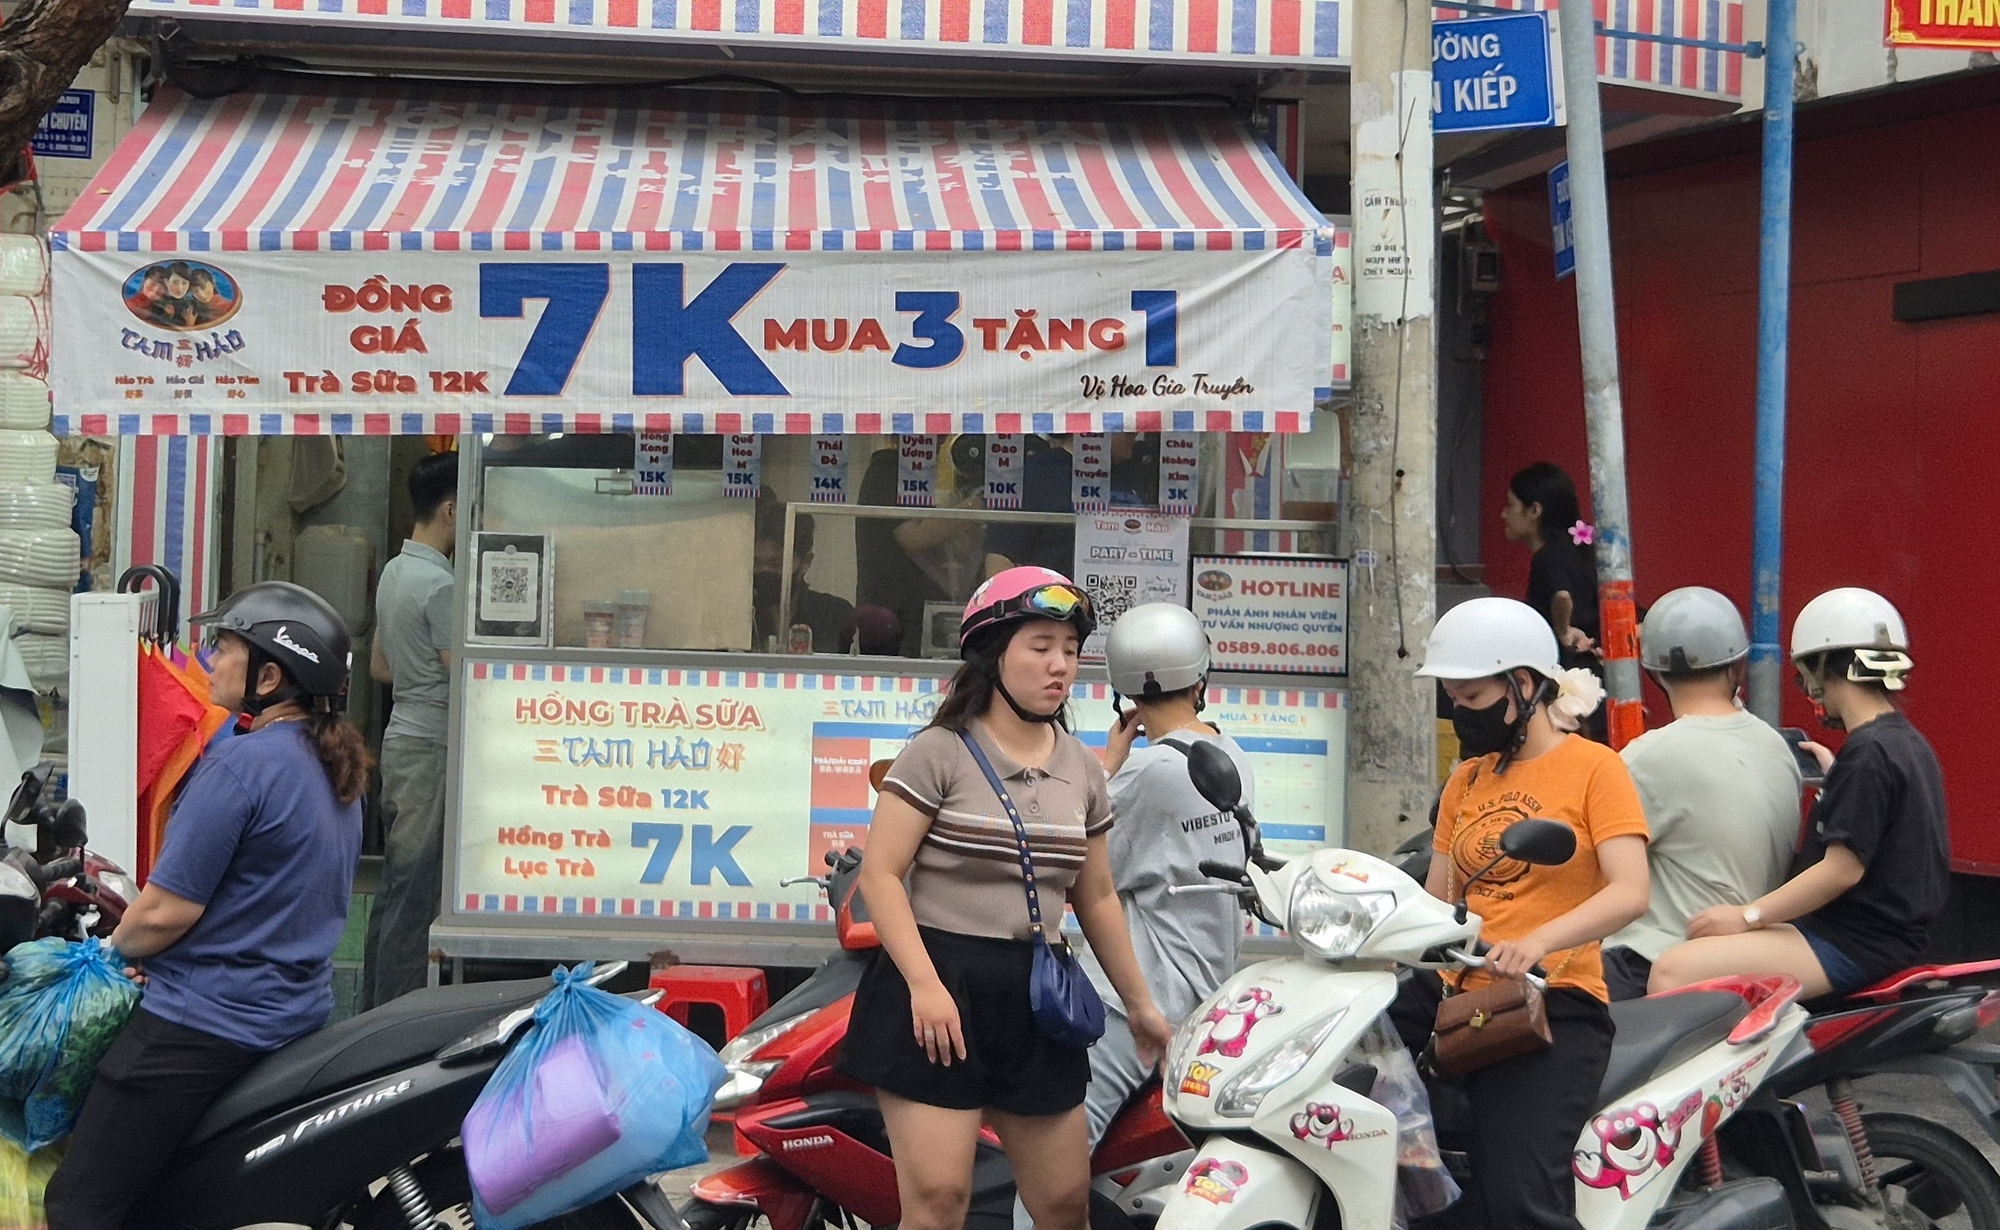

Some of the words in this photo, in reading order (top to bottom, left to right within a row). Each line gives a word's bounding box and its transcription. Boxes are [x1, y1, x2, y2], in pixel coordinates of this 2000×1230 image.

[1453, 63, 1518, 112] KIẾP
[321, 274, 453, 314] ĐỒNG
[350, 318, 430, 355] GIÁ
[480, 263, 793, 397] 7K
[763, 318, 894, 354] MUA
[891, 291, 968, 372] 3
[972, 308, 1127, 362] TẶNG
[1131, 290, 1180, 369] 1
[121, 327, 174, 362] TAM
[194, 329, 246, 362] HẢO
[283, 369, 342, 395] Trà
[351, 369, 418, 395] Sữa
[428, 370, 492, 395] 12K
[1080, 375, 1106, 400] Vị
[1110, 374, 1148, 397] Hoa
[1152, 374, 1187, 396] Gia
[998, 457, 1010, 467] M
[639, 471, 666, 483] 15K
[726, 473, 754, 485] 15K
[814, 477, 842, 489] 14K
[902, 480, 929, 492] 15K
[989, 482, 1017, 494] 10K
[1081, 486, 1101, 498] 5K
[1168, 489, 1188, 500] 3K
[1090, 546, 1127, 559] PART
[1139, 548, 1174, 561] TIME
[1240, 579, 1341, 599] HOTLINE
[1310, 609, 1338, 621] VIÊN
[1216, 641, 1341, 658] 0589.806.806
[515, 691, 612, 725] HỒNG
[619, 697, 690, 726] TRÀ
[695, 699, 764, 729] SỮA
[1219, 712, 1248, 722] MUA
[562, 737, 634, 767] TAM
[647, 736, 712, 770] HẢO
[541, 784, 589, 807] Trà
[598, 785, 653, 809] Sữa
[661, 788, 711, 810] 12K
[498, 825, 564, 850] Hồng
[571, 828, 612, 849] Trà
[631, 822, 754, 887] 7K
[504, 857, 549, 879] Lục
[555, 857, 596, 877] Trà
[1187, 1060, 1221, 1082] TOY
[292, 1079, 414, 1143] FUTURE
[782, 1134, 835, 1151] HONDA
